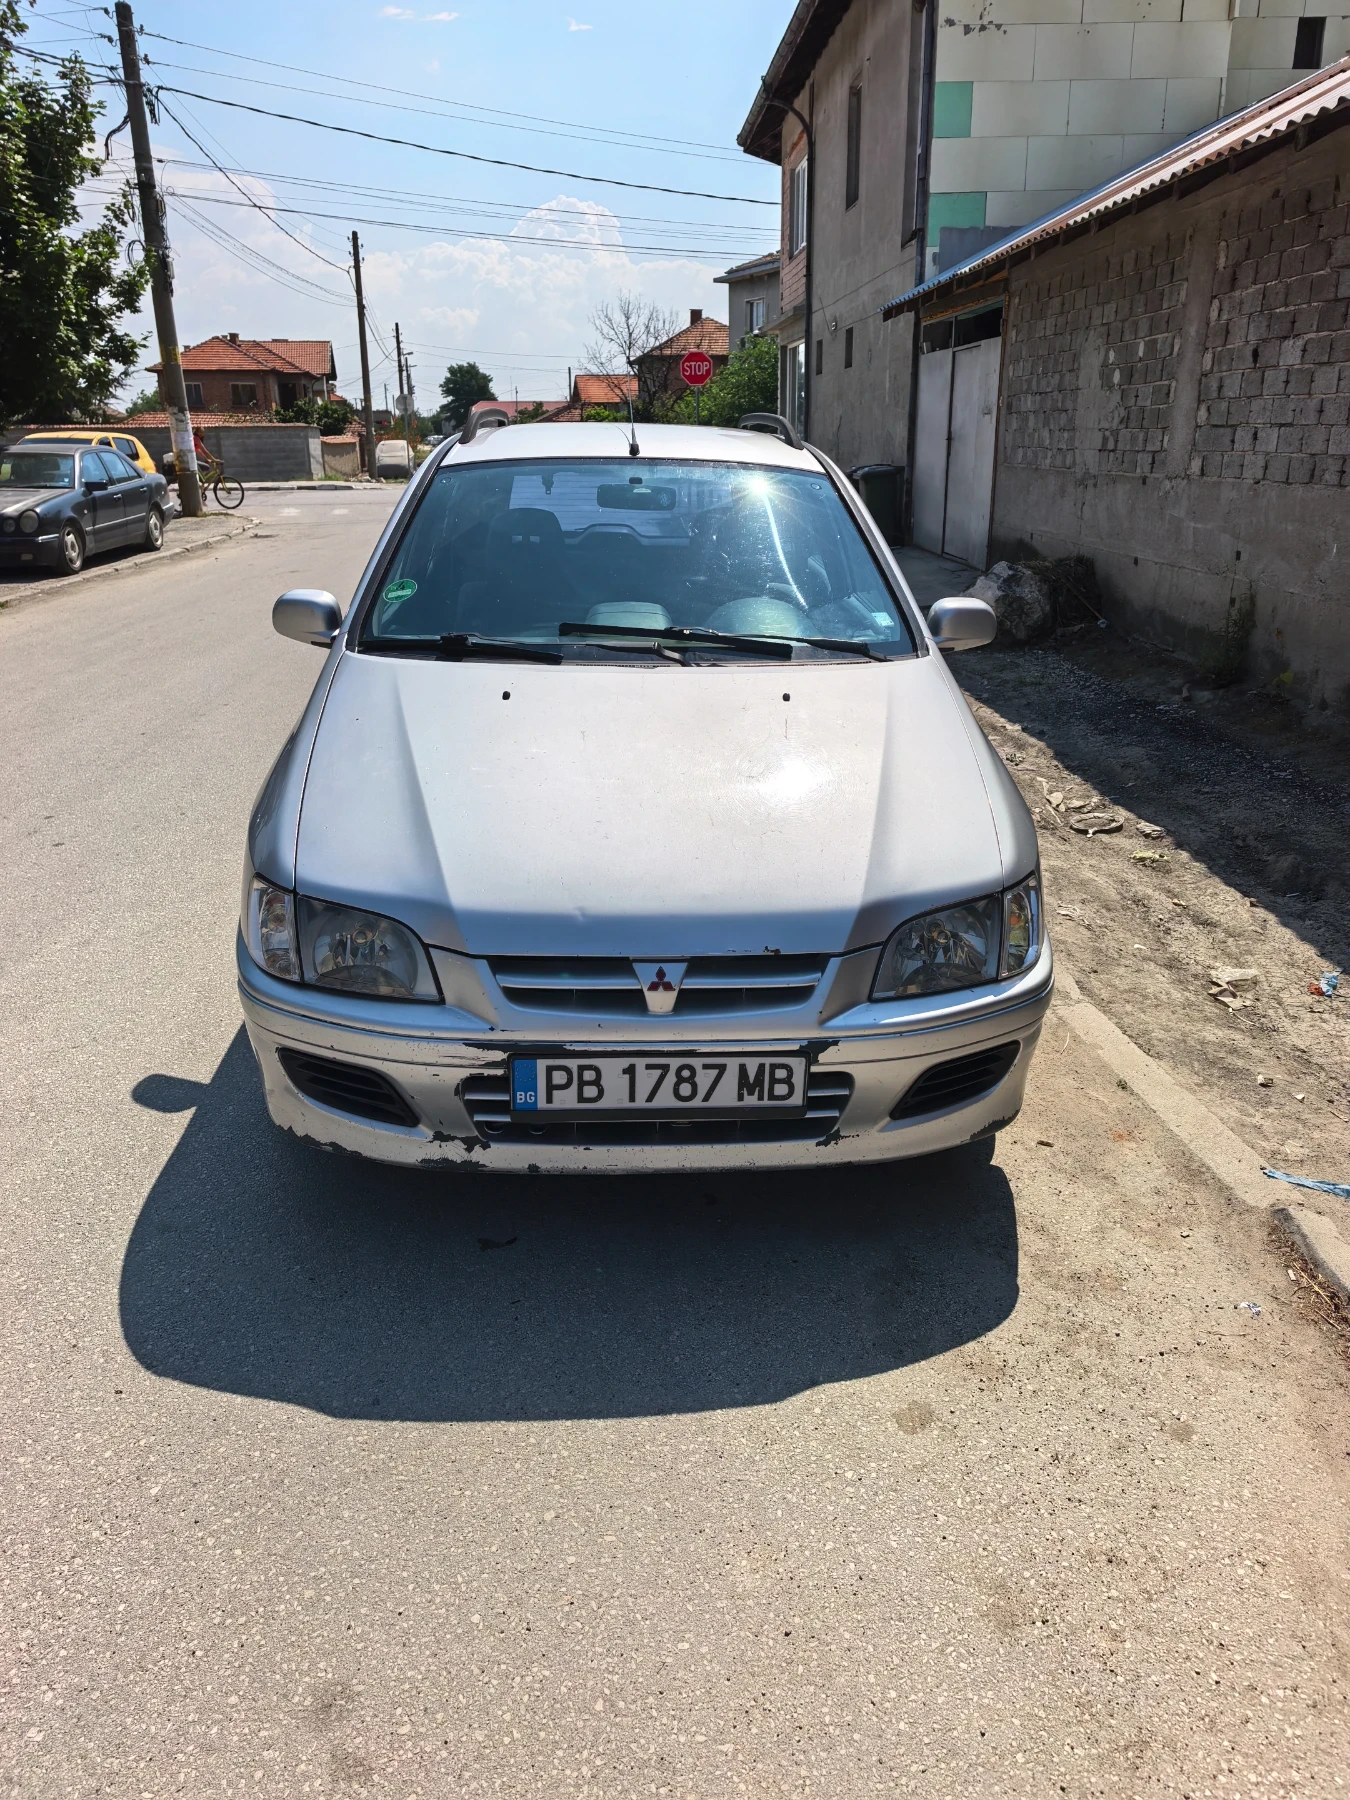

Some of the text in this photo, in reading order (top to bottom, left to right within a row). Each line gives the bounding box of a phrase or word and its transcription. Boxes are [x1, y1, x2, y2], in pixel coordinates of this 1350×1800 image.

[684, 361, 709, 375] STOP
[545, 1062, 796, 1104] PB 1787 MB
[516, 1091, 535, 1103] BG
